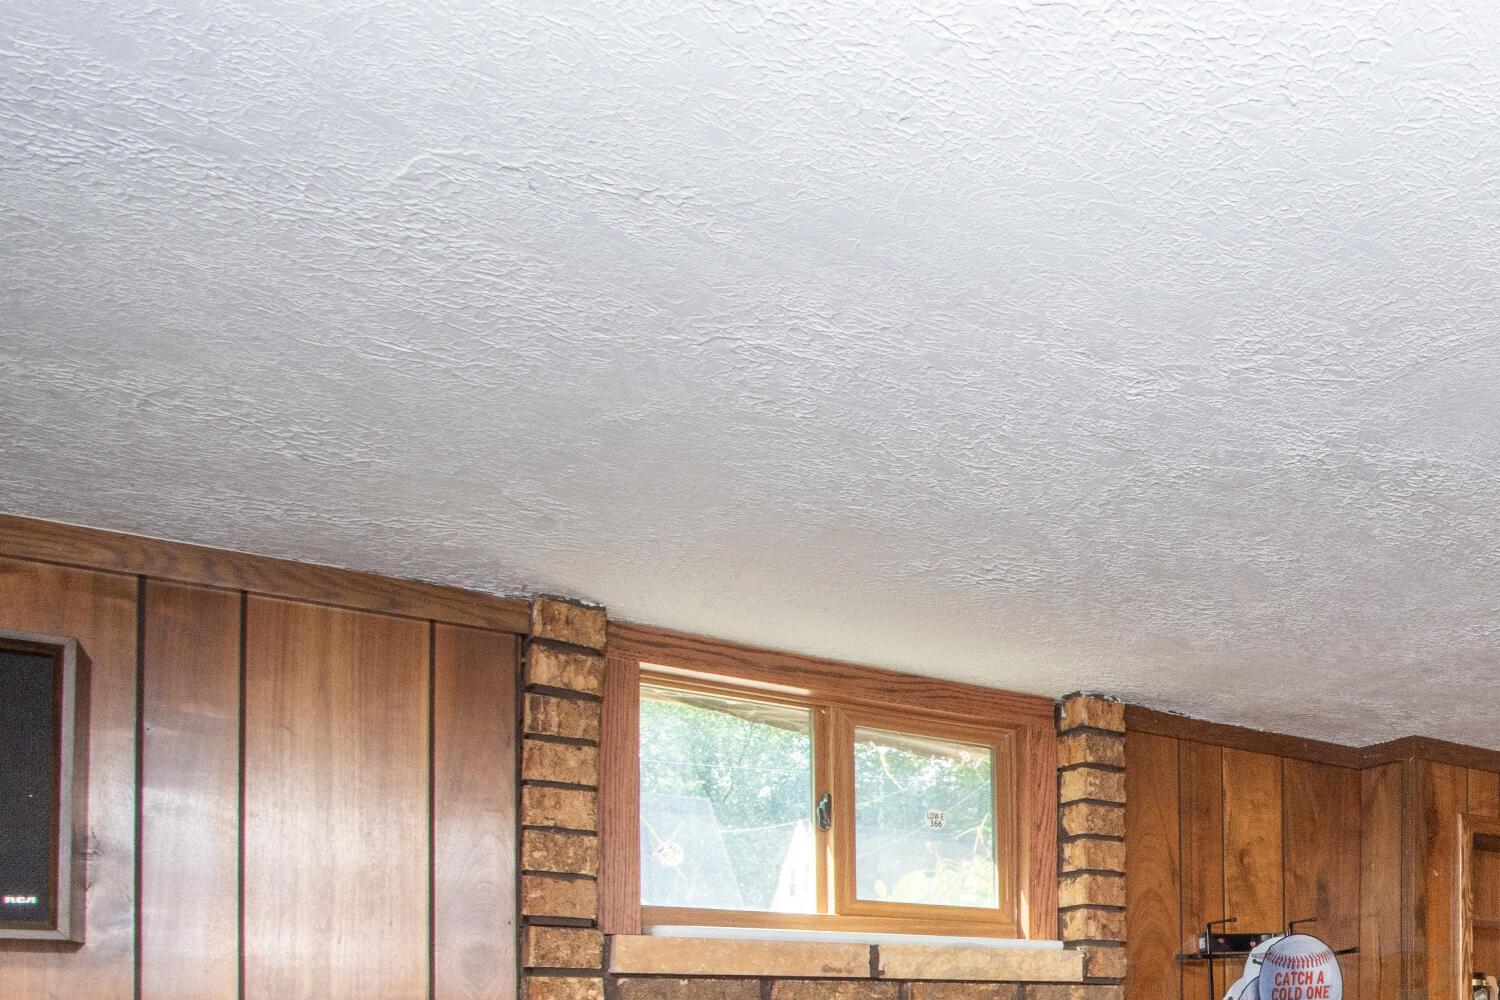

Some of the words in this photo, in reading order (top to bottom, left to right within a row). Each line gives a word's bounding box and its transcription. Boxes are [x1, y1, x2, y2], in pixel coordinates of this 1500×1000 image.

[3, 896, 38, 904] RCA
[1274, 971, 1313, 986] CATCH
[1317, 970, 1325, 984] A
[1306, 985, 1329, 1000] ONE
